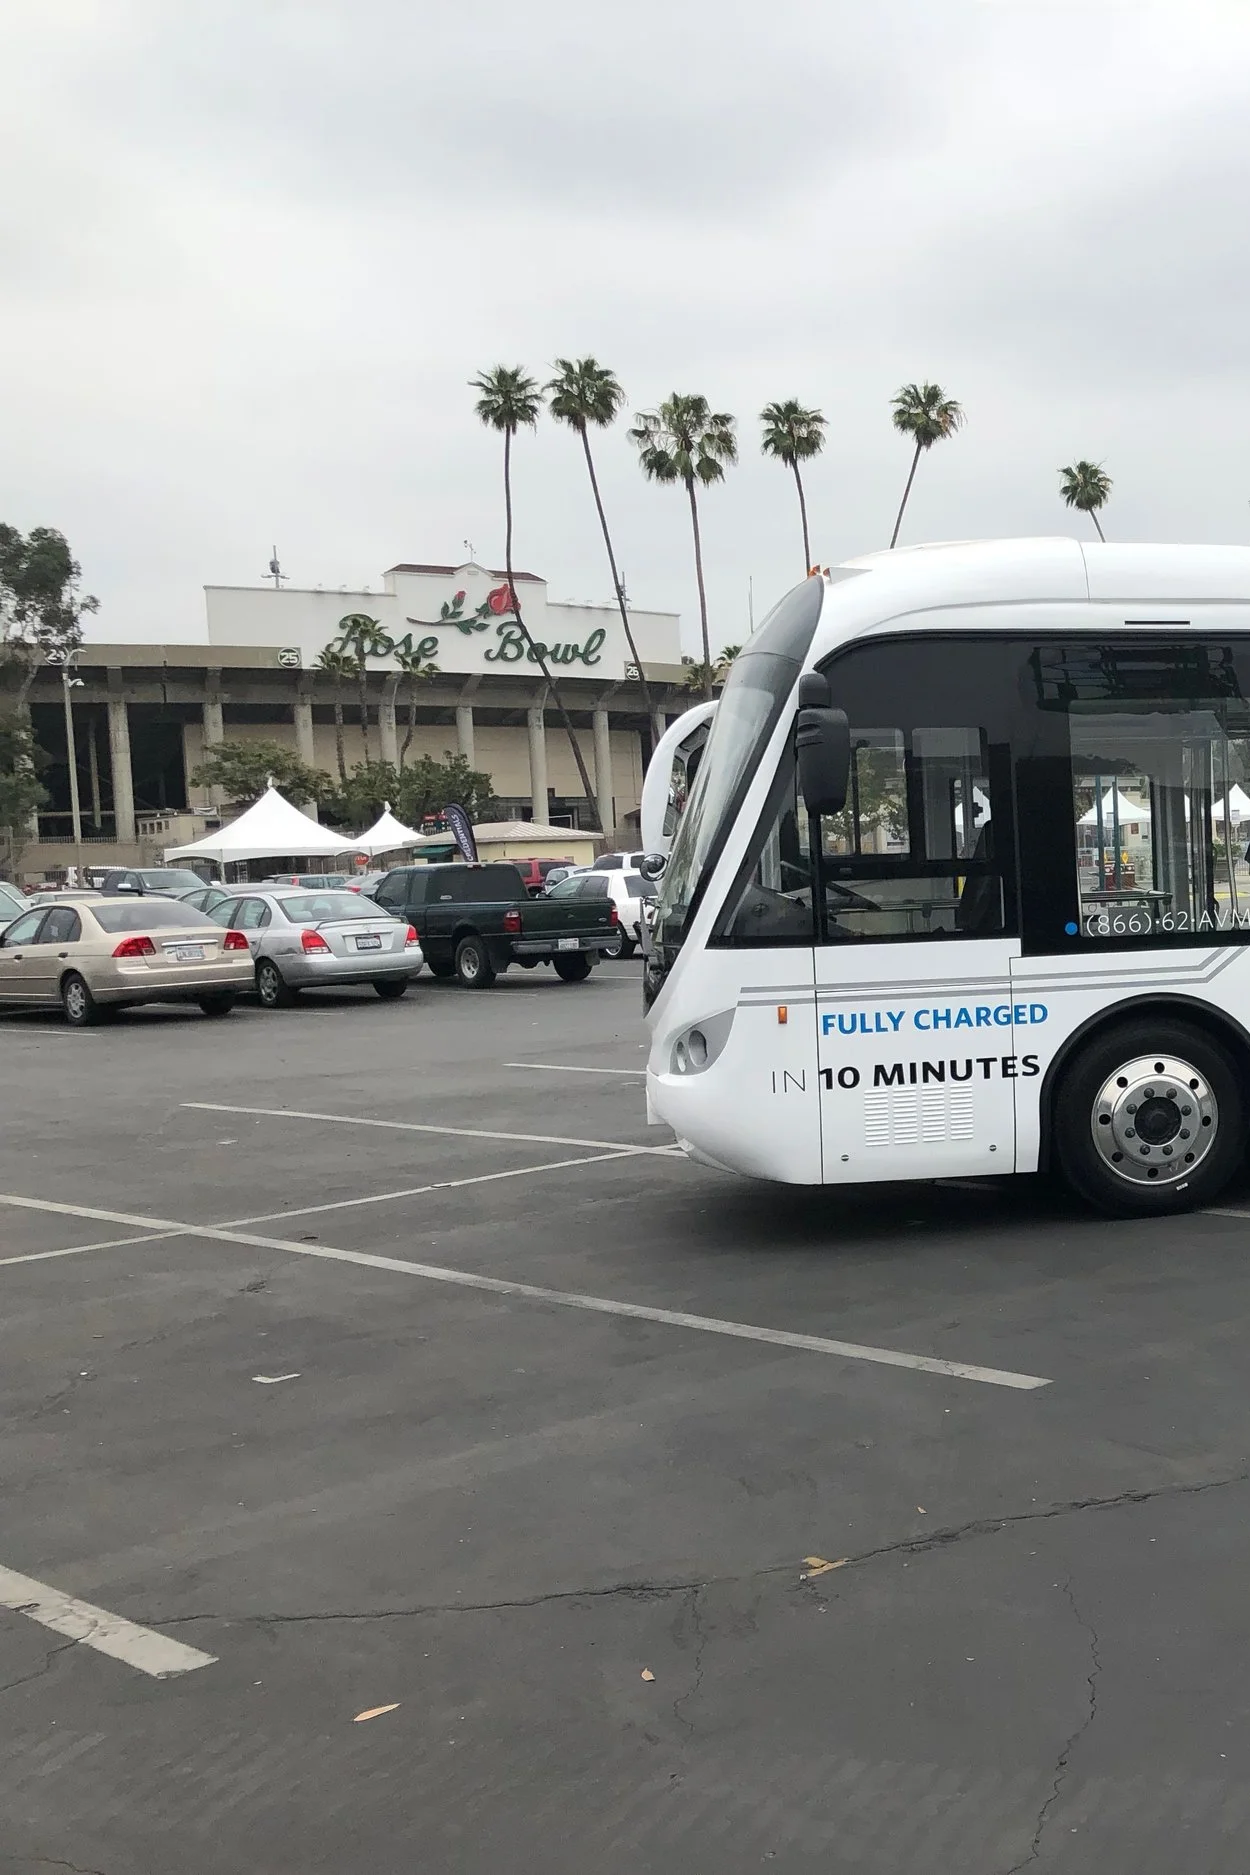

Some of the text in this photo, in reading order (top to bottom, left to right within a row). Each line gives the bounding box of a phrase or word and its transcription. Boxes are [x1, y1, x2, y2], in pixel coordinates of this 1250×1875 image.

[280, 652, 298, 663] 25
[484, 620, 606, 666] Bowl
[627, 666, 639, 676] 26
[451, 814, 473, 861] CREDENTIALS
[822, 1003, 1049, 1036] FULLY CHARGED
[772, 1054, 1041, 1094] IN 10 MINUTES
